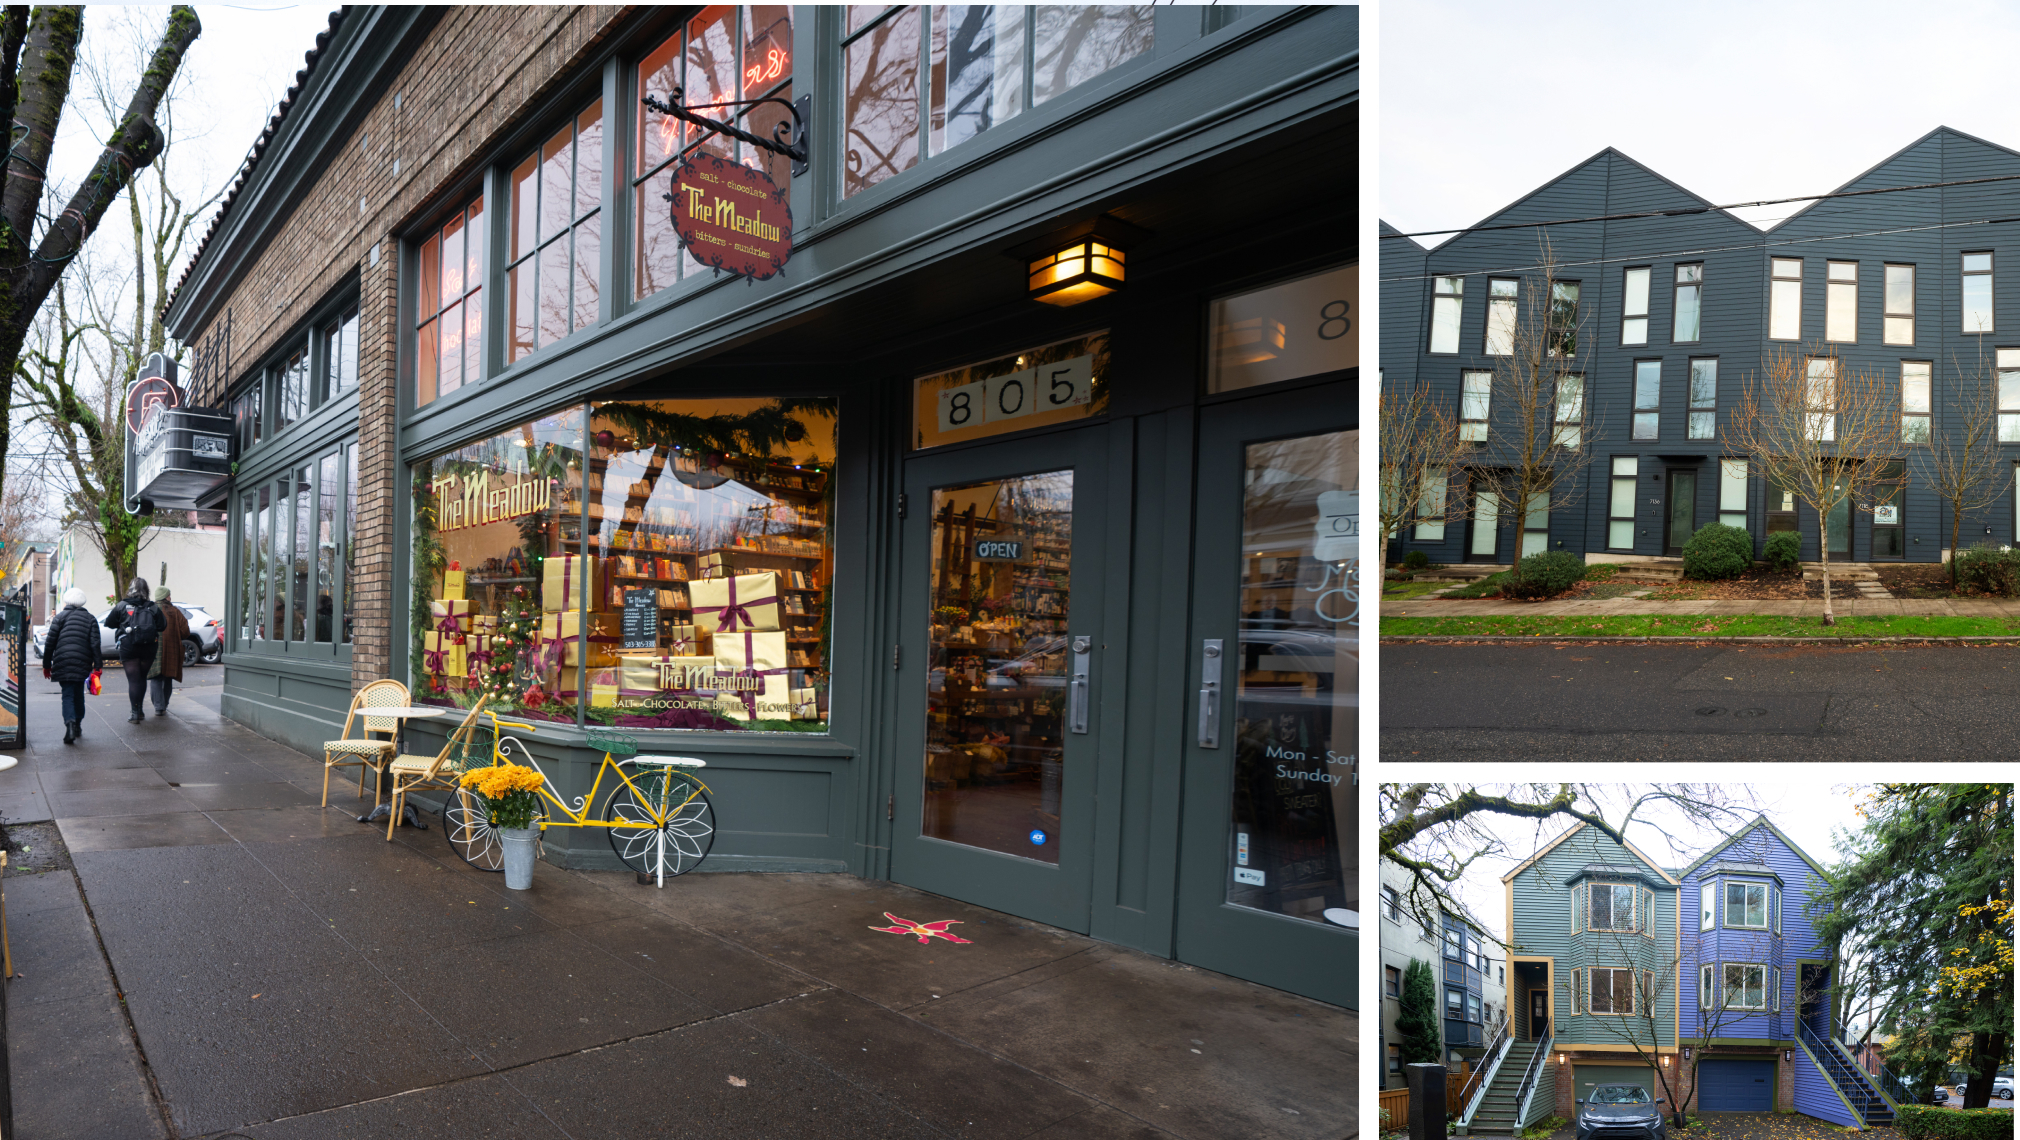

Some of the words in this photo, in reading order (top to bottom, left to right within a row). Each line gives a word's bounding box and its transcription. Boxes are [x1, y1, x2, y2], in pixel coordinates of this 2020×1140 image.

[699, 171, 719, 184] salt
[727, 180, 767, 199] chocolate
[681, 182, 713, 224] The
[714, 196, 780, 243] Meadow
[695, 229, 727, 247] bitters
[734, 242, 771, 259] sundries
[443, 258, 477, 298] Sat
[949, 368, 1074, 425] 805
[432, 473, 462, 533] The
[463, 460, 551, 528] Meadow
[651, 661, 683, 691] The
[684, 664, 759, 692] Meadow
[611, 697, 634, 708] SALT
[643, 698, 704, 710] CHOCOLATE
[712, 701, 749, 711] BITTERS
[757, 702, 802, 713] FLOWERS
[1266, 745, 1306, 760] Mon
[1326, 750, 1356, 765] Sat
[1276, 764, 1342, 787] Sunday
[1246, 872, 1262, 882] Pay
